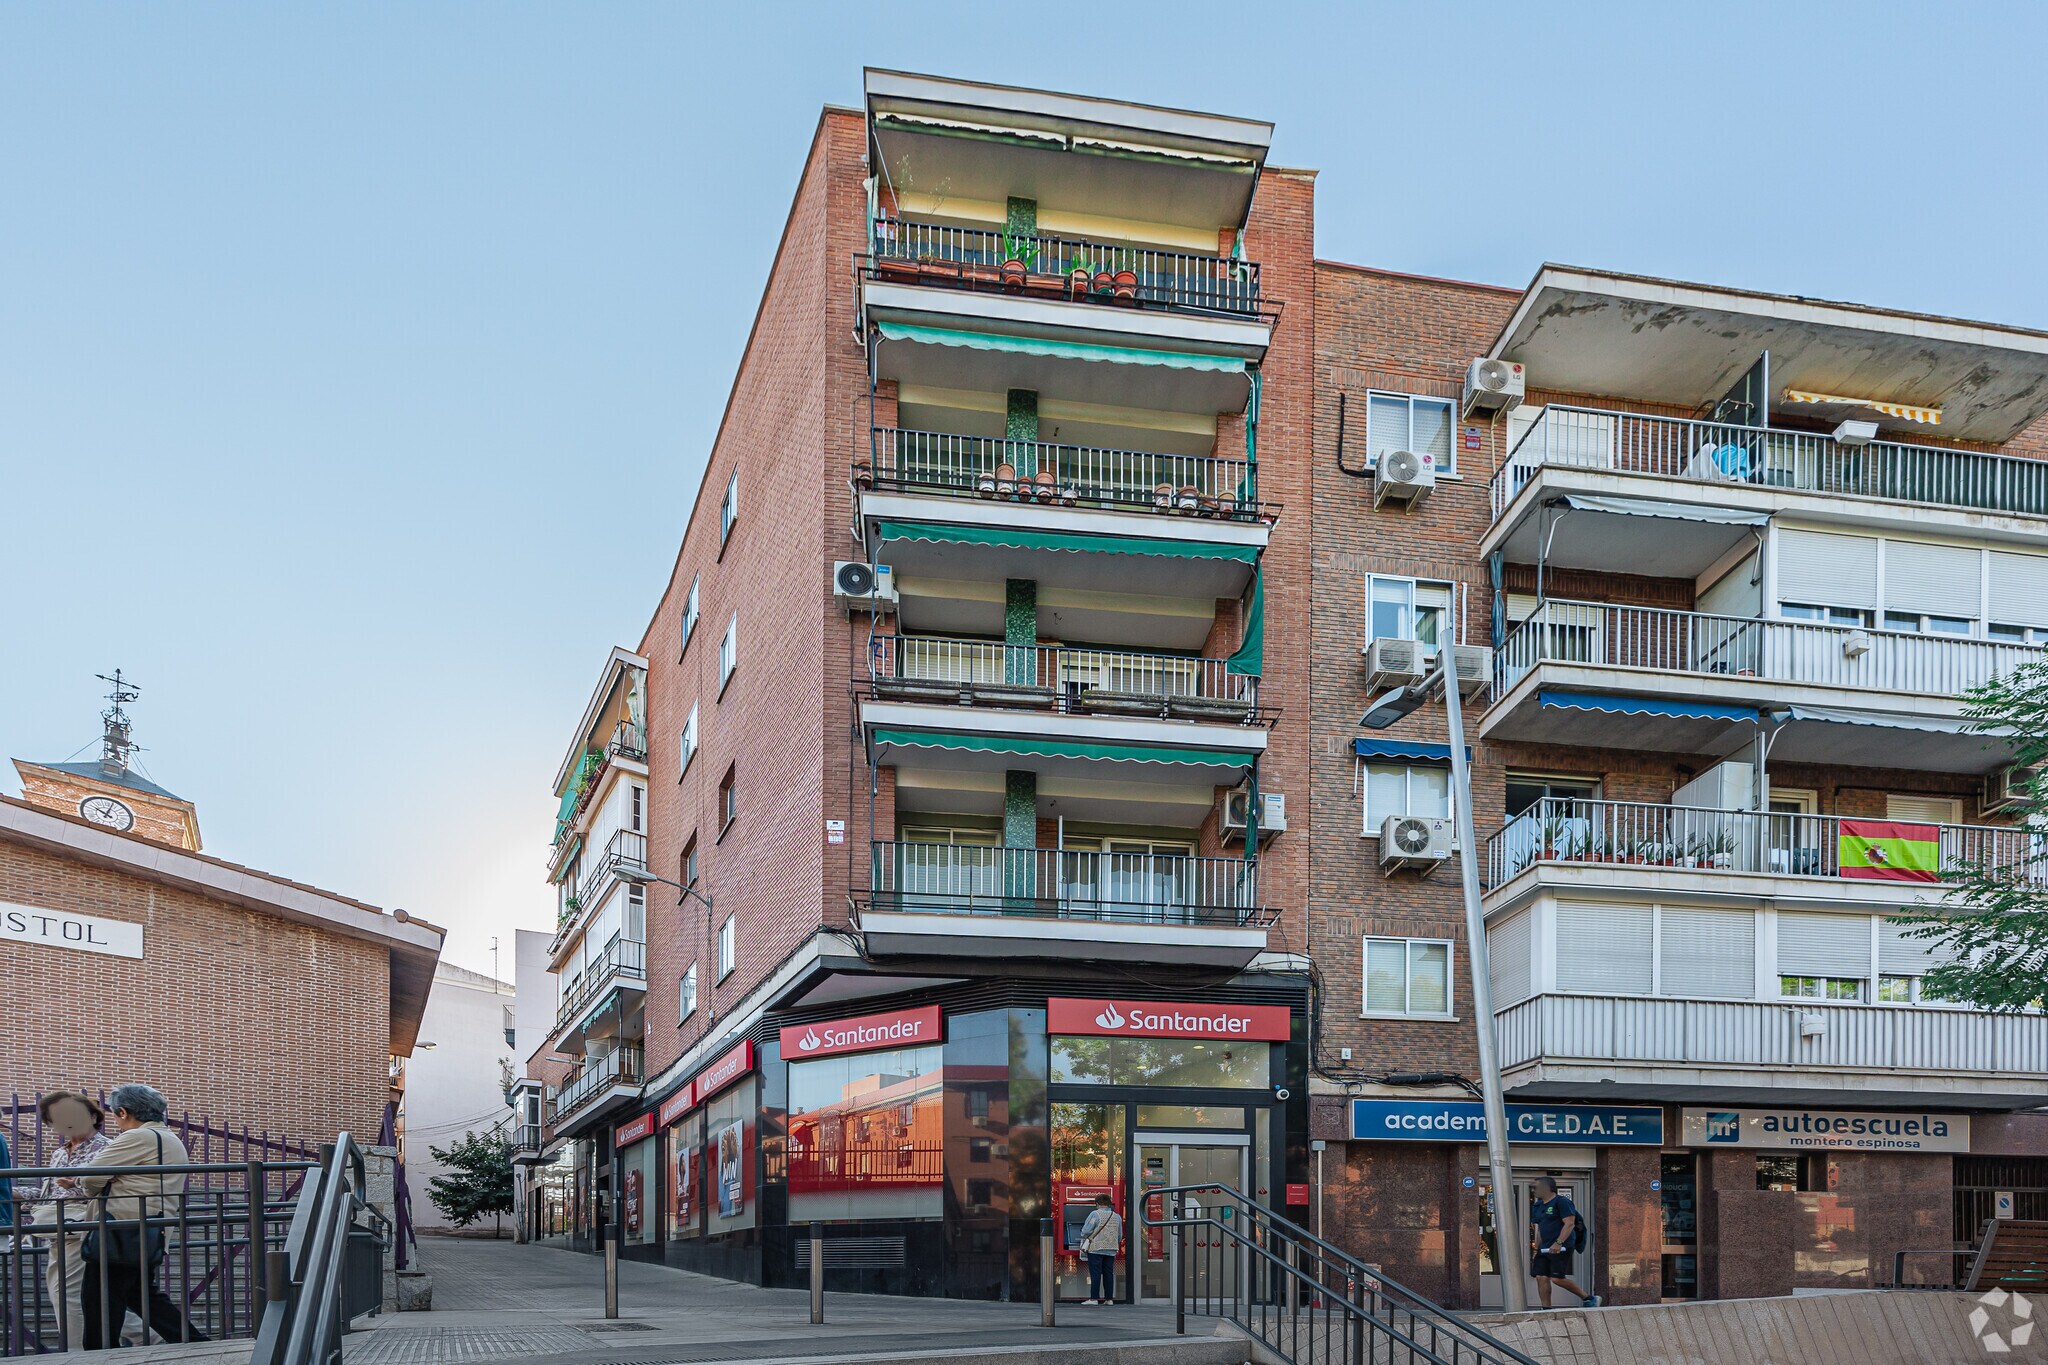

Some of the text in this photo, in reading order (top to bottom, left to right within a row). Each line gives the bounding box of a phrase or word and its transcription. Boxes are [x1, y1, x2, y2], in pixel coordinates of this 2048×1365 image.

[0, 912, 108, 945] STOL
[823, 1019, 922, 1048] Santander
[1129, 1010, 1252, 1033] Santander
[710, 1058, 738, 1087] Santander
[668, 1095, 688, 1118] Santander
[624, 1122, 645, 1139] Santander
[1385, 1111, 1634, 1136] academ C.E.D.A.E.
[1763, 1113, 1949, 1137] autoescuela
[1790, 1137, 1921, 1149] montero espinosa
